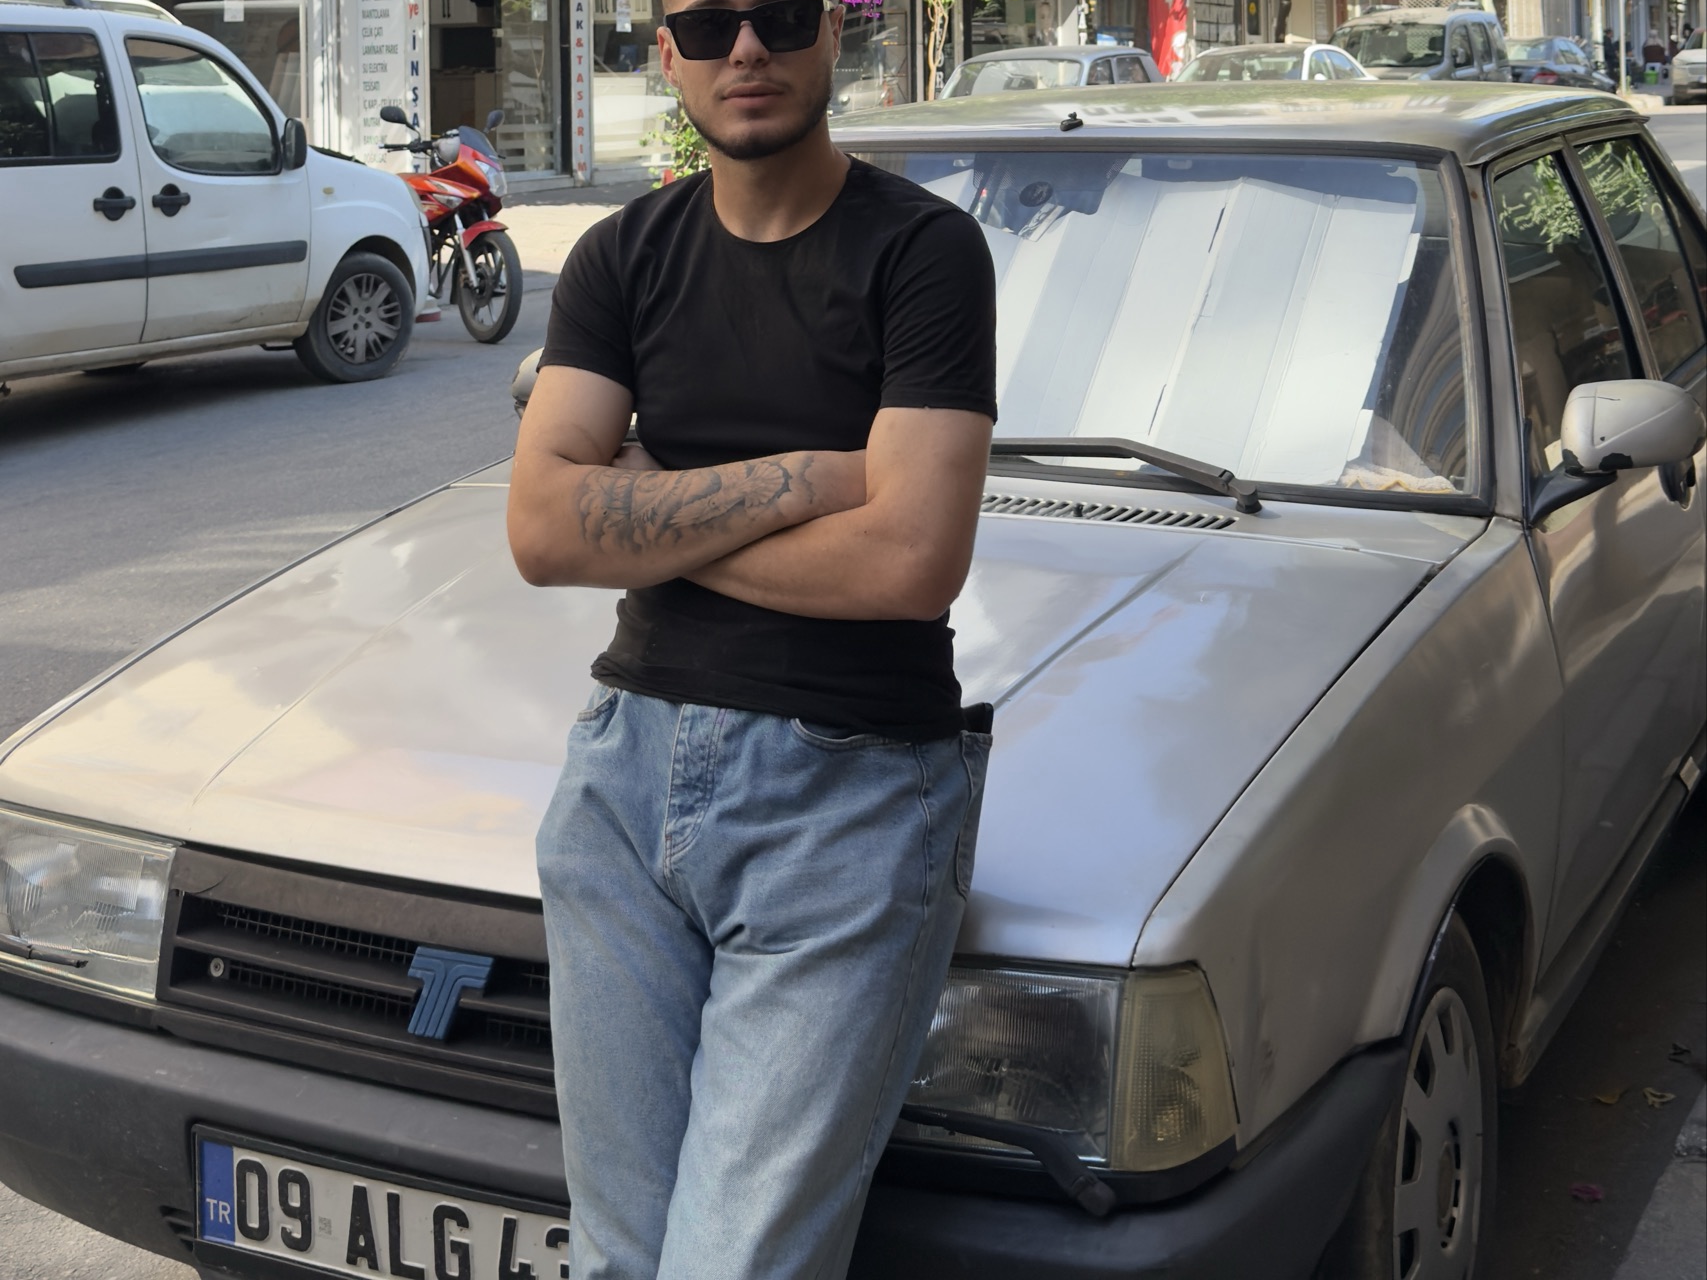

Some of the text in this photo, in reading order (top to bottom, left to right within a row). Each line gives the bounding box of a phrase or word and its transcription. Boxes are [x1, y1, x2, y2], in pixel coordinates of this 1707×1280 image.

[408, 3, 419, 19] ye
[575, 37, 584, 48] &
[576, 55, 587, 172] TASARIM
[205, 1197, 232, 1225] TR
[236, 1157, 313, 1253] 09
[346, 1183, 472, 1280] ALG
